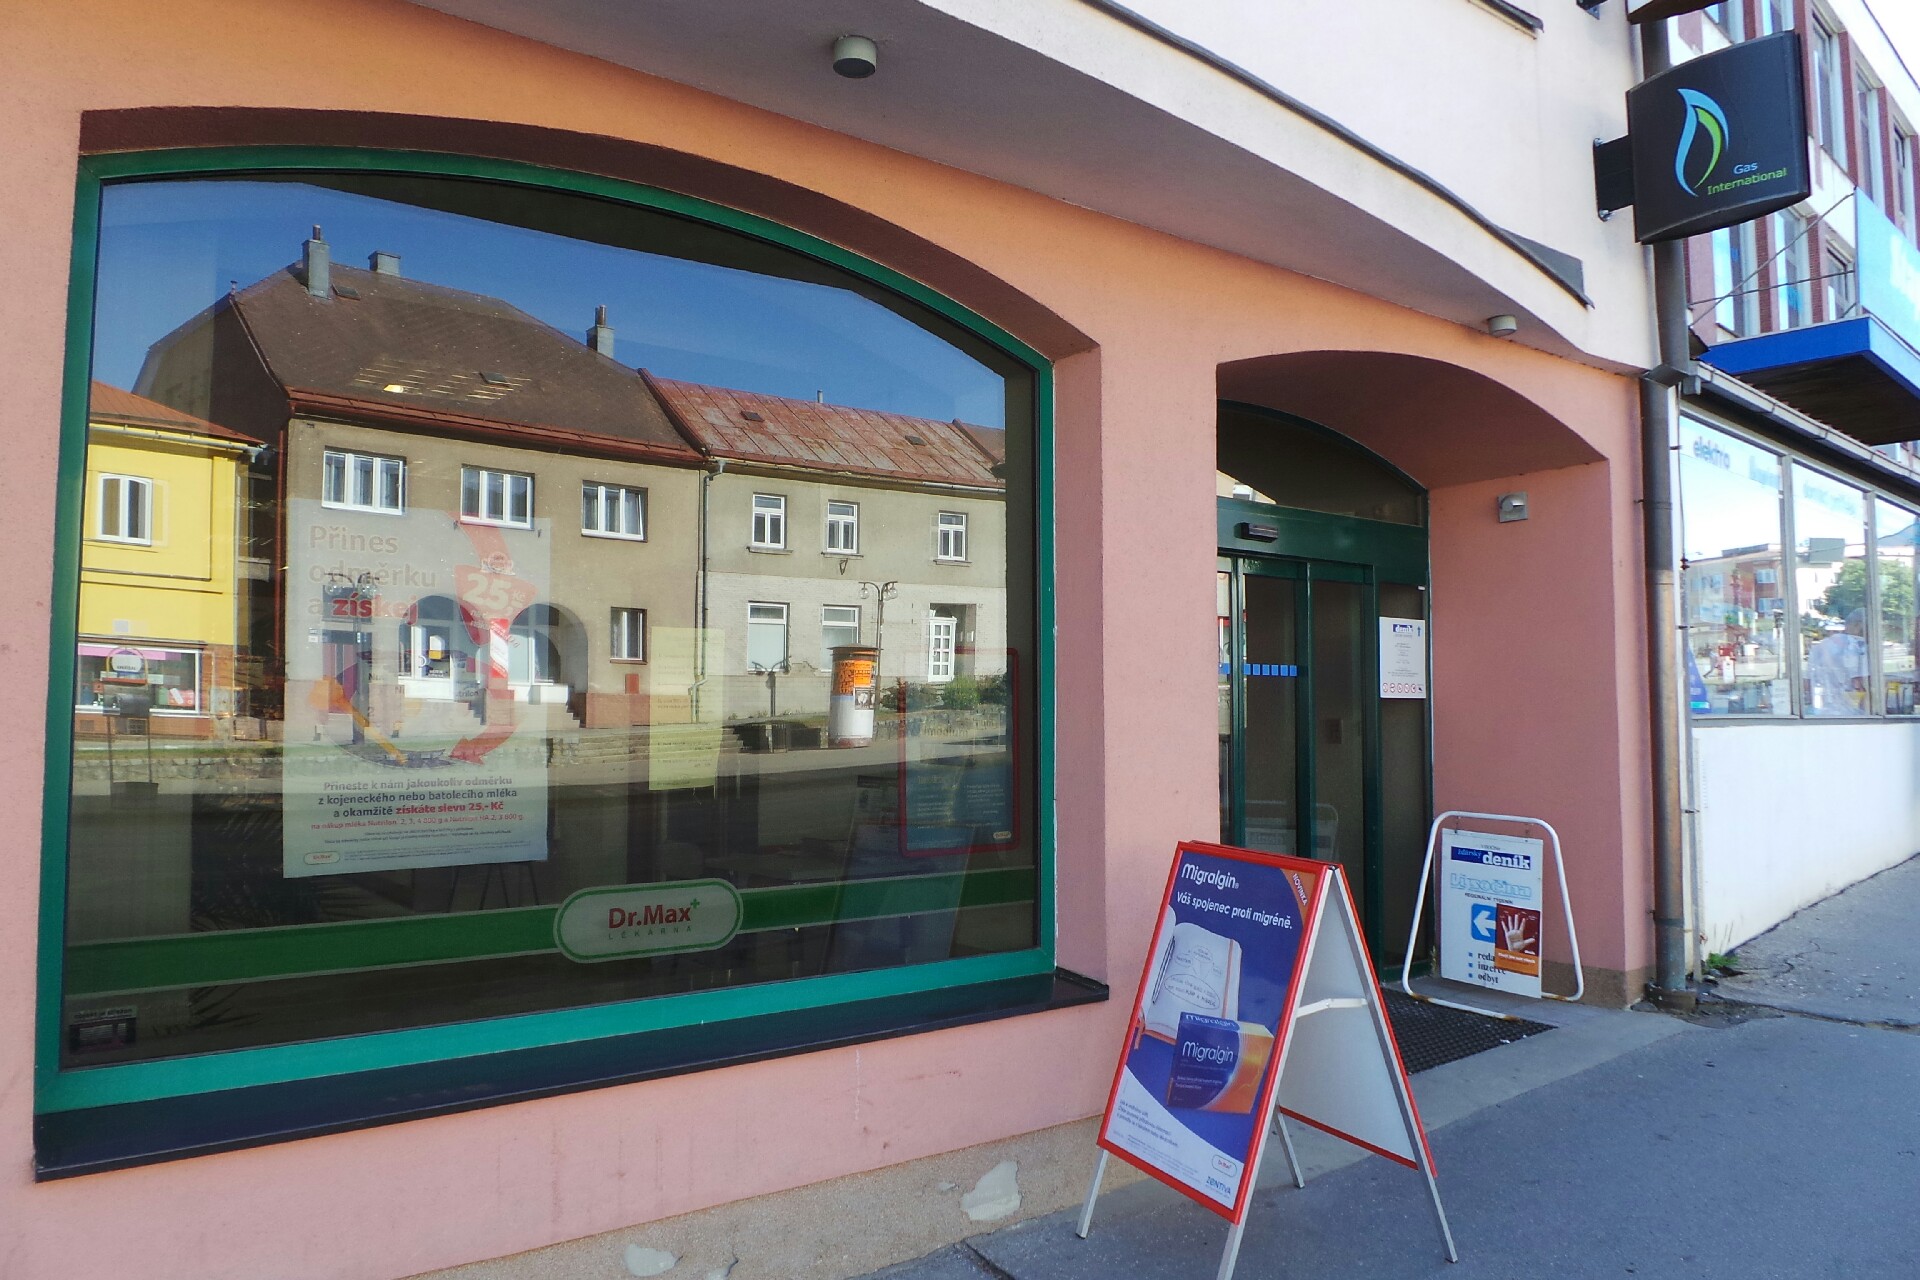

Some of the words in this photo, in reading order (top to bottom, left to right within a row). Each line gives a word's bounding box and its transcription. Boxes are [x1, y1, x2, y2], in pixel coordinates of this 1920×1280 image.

[1707, 168, 1788, 196] International
[1733, 162, 1758, 178] Gas
[309, 525, 399, 555] Přines
[308, 559, 436, 588] odměrku
[308, 602, 322, 616] a
[332, 592, 418, 626] získej
[324, 781, 369, 791] Přineste
[380, 779, 404, 790] nám
[407, 777, 463, 790] jakoukoliv
[465, 776, 513, 787] odměrku
[319, 798, 325, 806] z
[327, 793, 396, 807] kojeneckého
[399, 792, 426, 802] nebo
[428, 790, 485, 801] batolecího
[487, 788, 518, 799] mléka
[333, 810, 341, 818] a
[438, 803, 467, 814] slevu
[491, 800, 505, 811] Kč
[1482, 851, 1530, 870] deník
[1292, 873, 1308, 906] NOVINKA
[608, 904, 691, 930] Dr.Max
[1176, 891, 1192, 905] Váš
[1191, 898, 1230, 915] spojenec
[1231, 907, 1253, 920] proti
[1252, 911, 1293, 930] migréně.
[1477, 972, 1499, 985] odbyt
[1182, 1041, 1234, 1065] Migralgin
